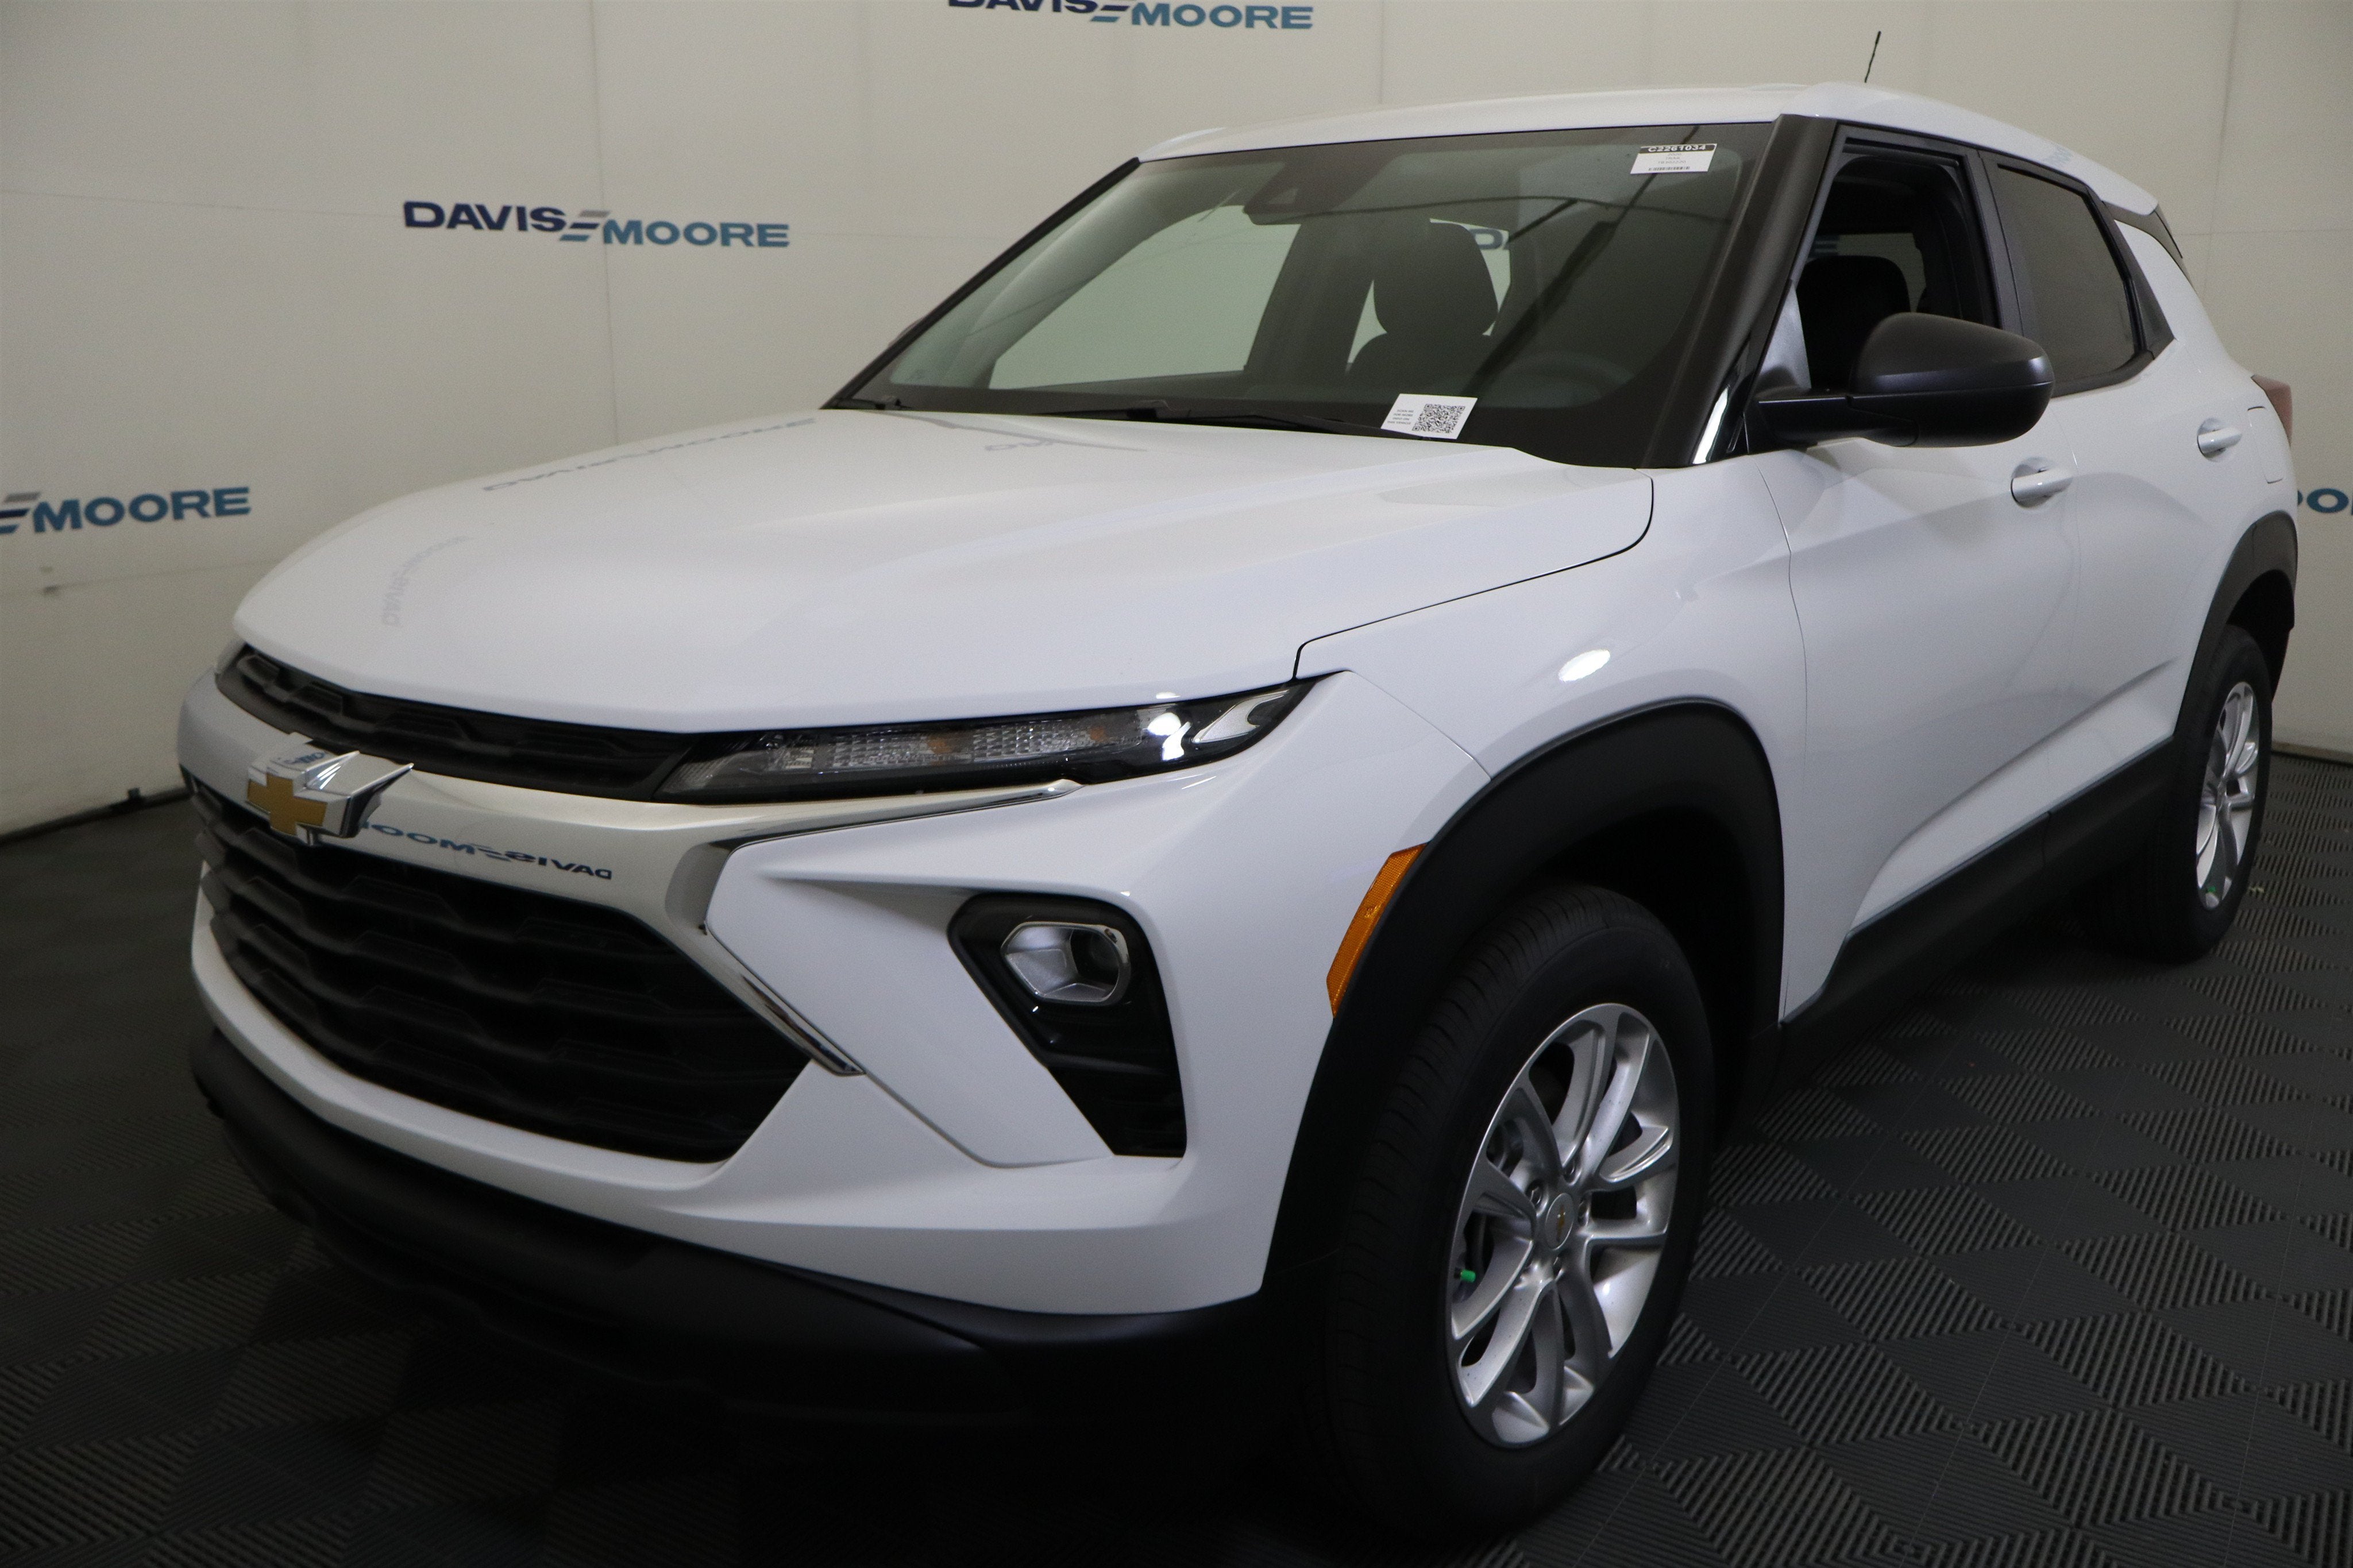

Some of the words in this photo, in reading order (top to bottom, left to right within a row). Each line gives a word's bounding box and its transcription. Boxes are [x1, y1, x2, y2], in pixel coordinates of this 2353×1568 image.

[1131, 2, 1314, 29] MOORE
[1648, 144, 1706, 153] C2261034
[403, 200, 566, 232] DAVIS
[603, 219, 790, 248] MOORE
[32, 486, 251, 533] MOORE
